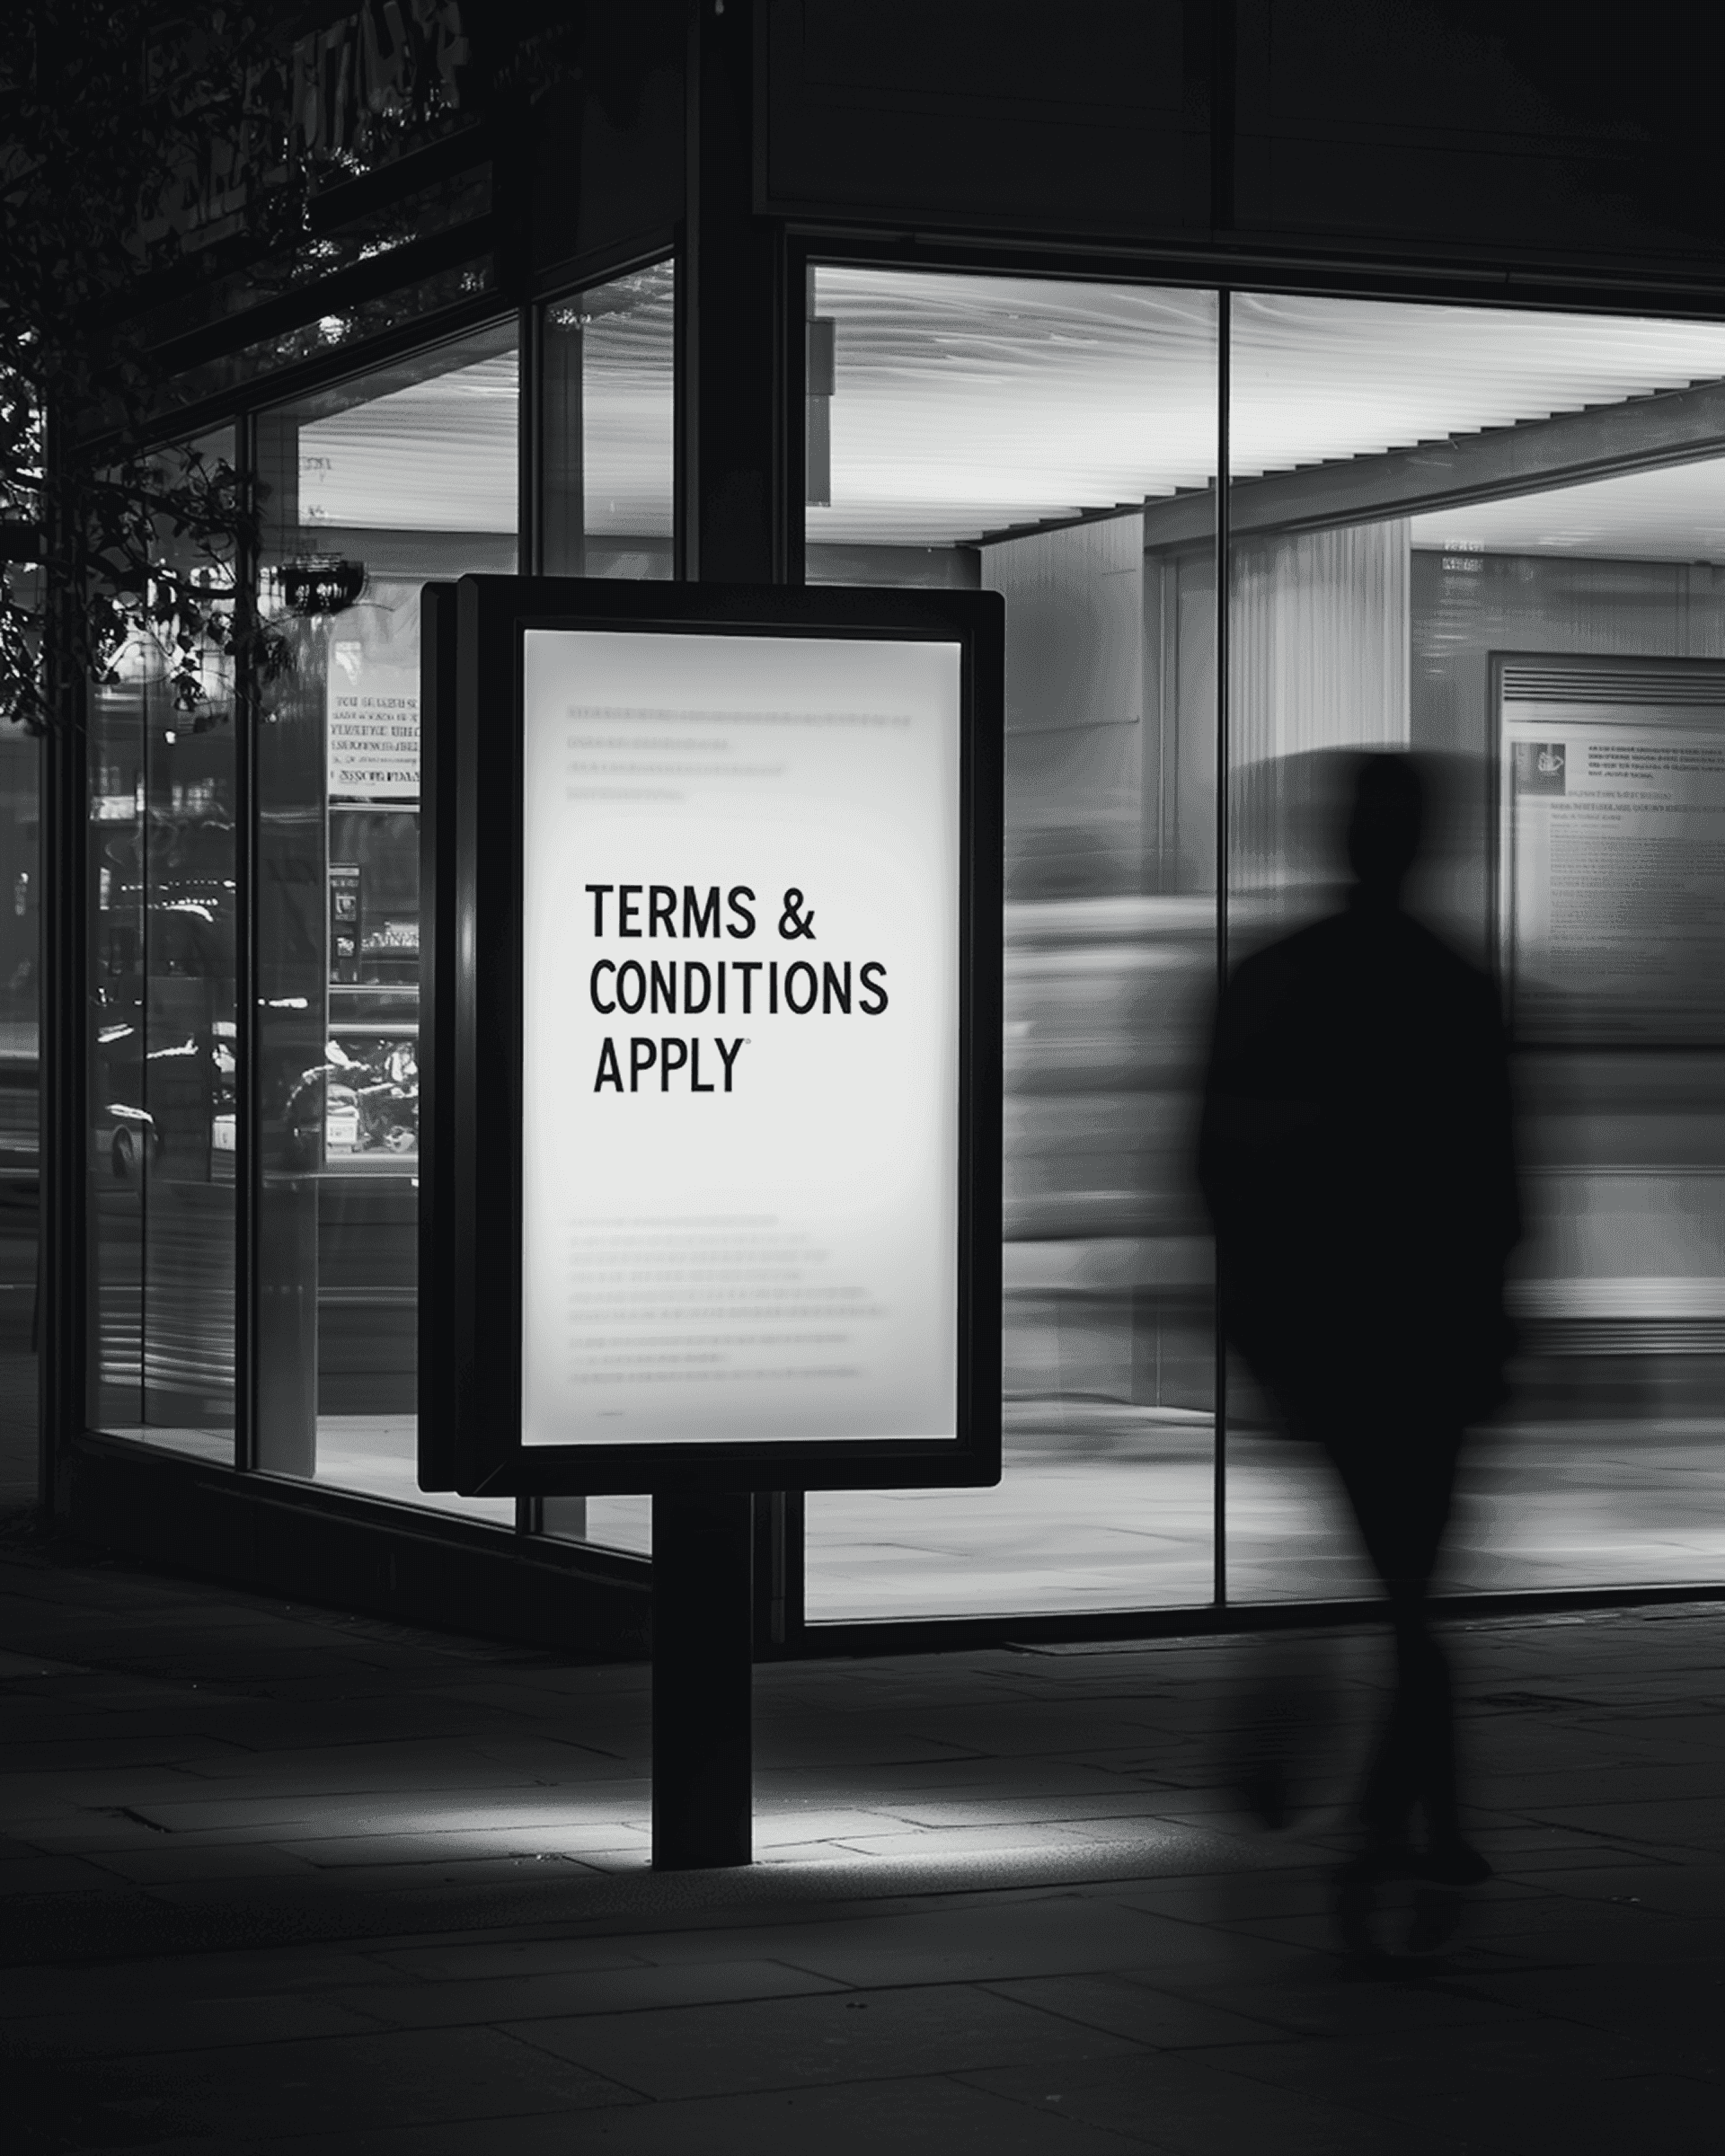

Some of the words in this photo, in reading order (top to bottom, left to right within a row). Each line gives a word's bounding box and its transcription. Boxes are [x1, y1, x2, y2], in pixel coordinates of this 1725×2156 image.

[585, 884, 756, 940] TERMS
[778, 887, 817, 941] &
[589, 959, 889, 1016] CONDITIONS
[593, 1037, 745, 1093] APPLY
